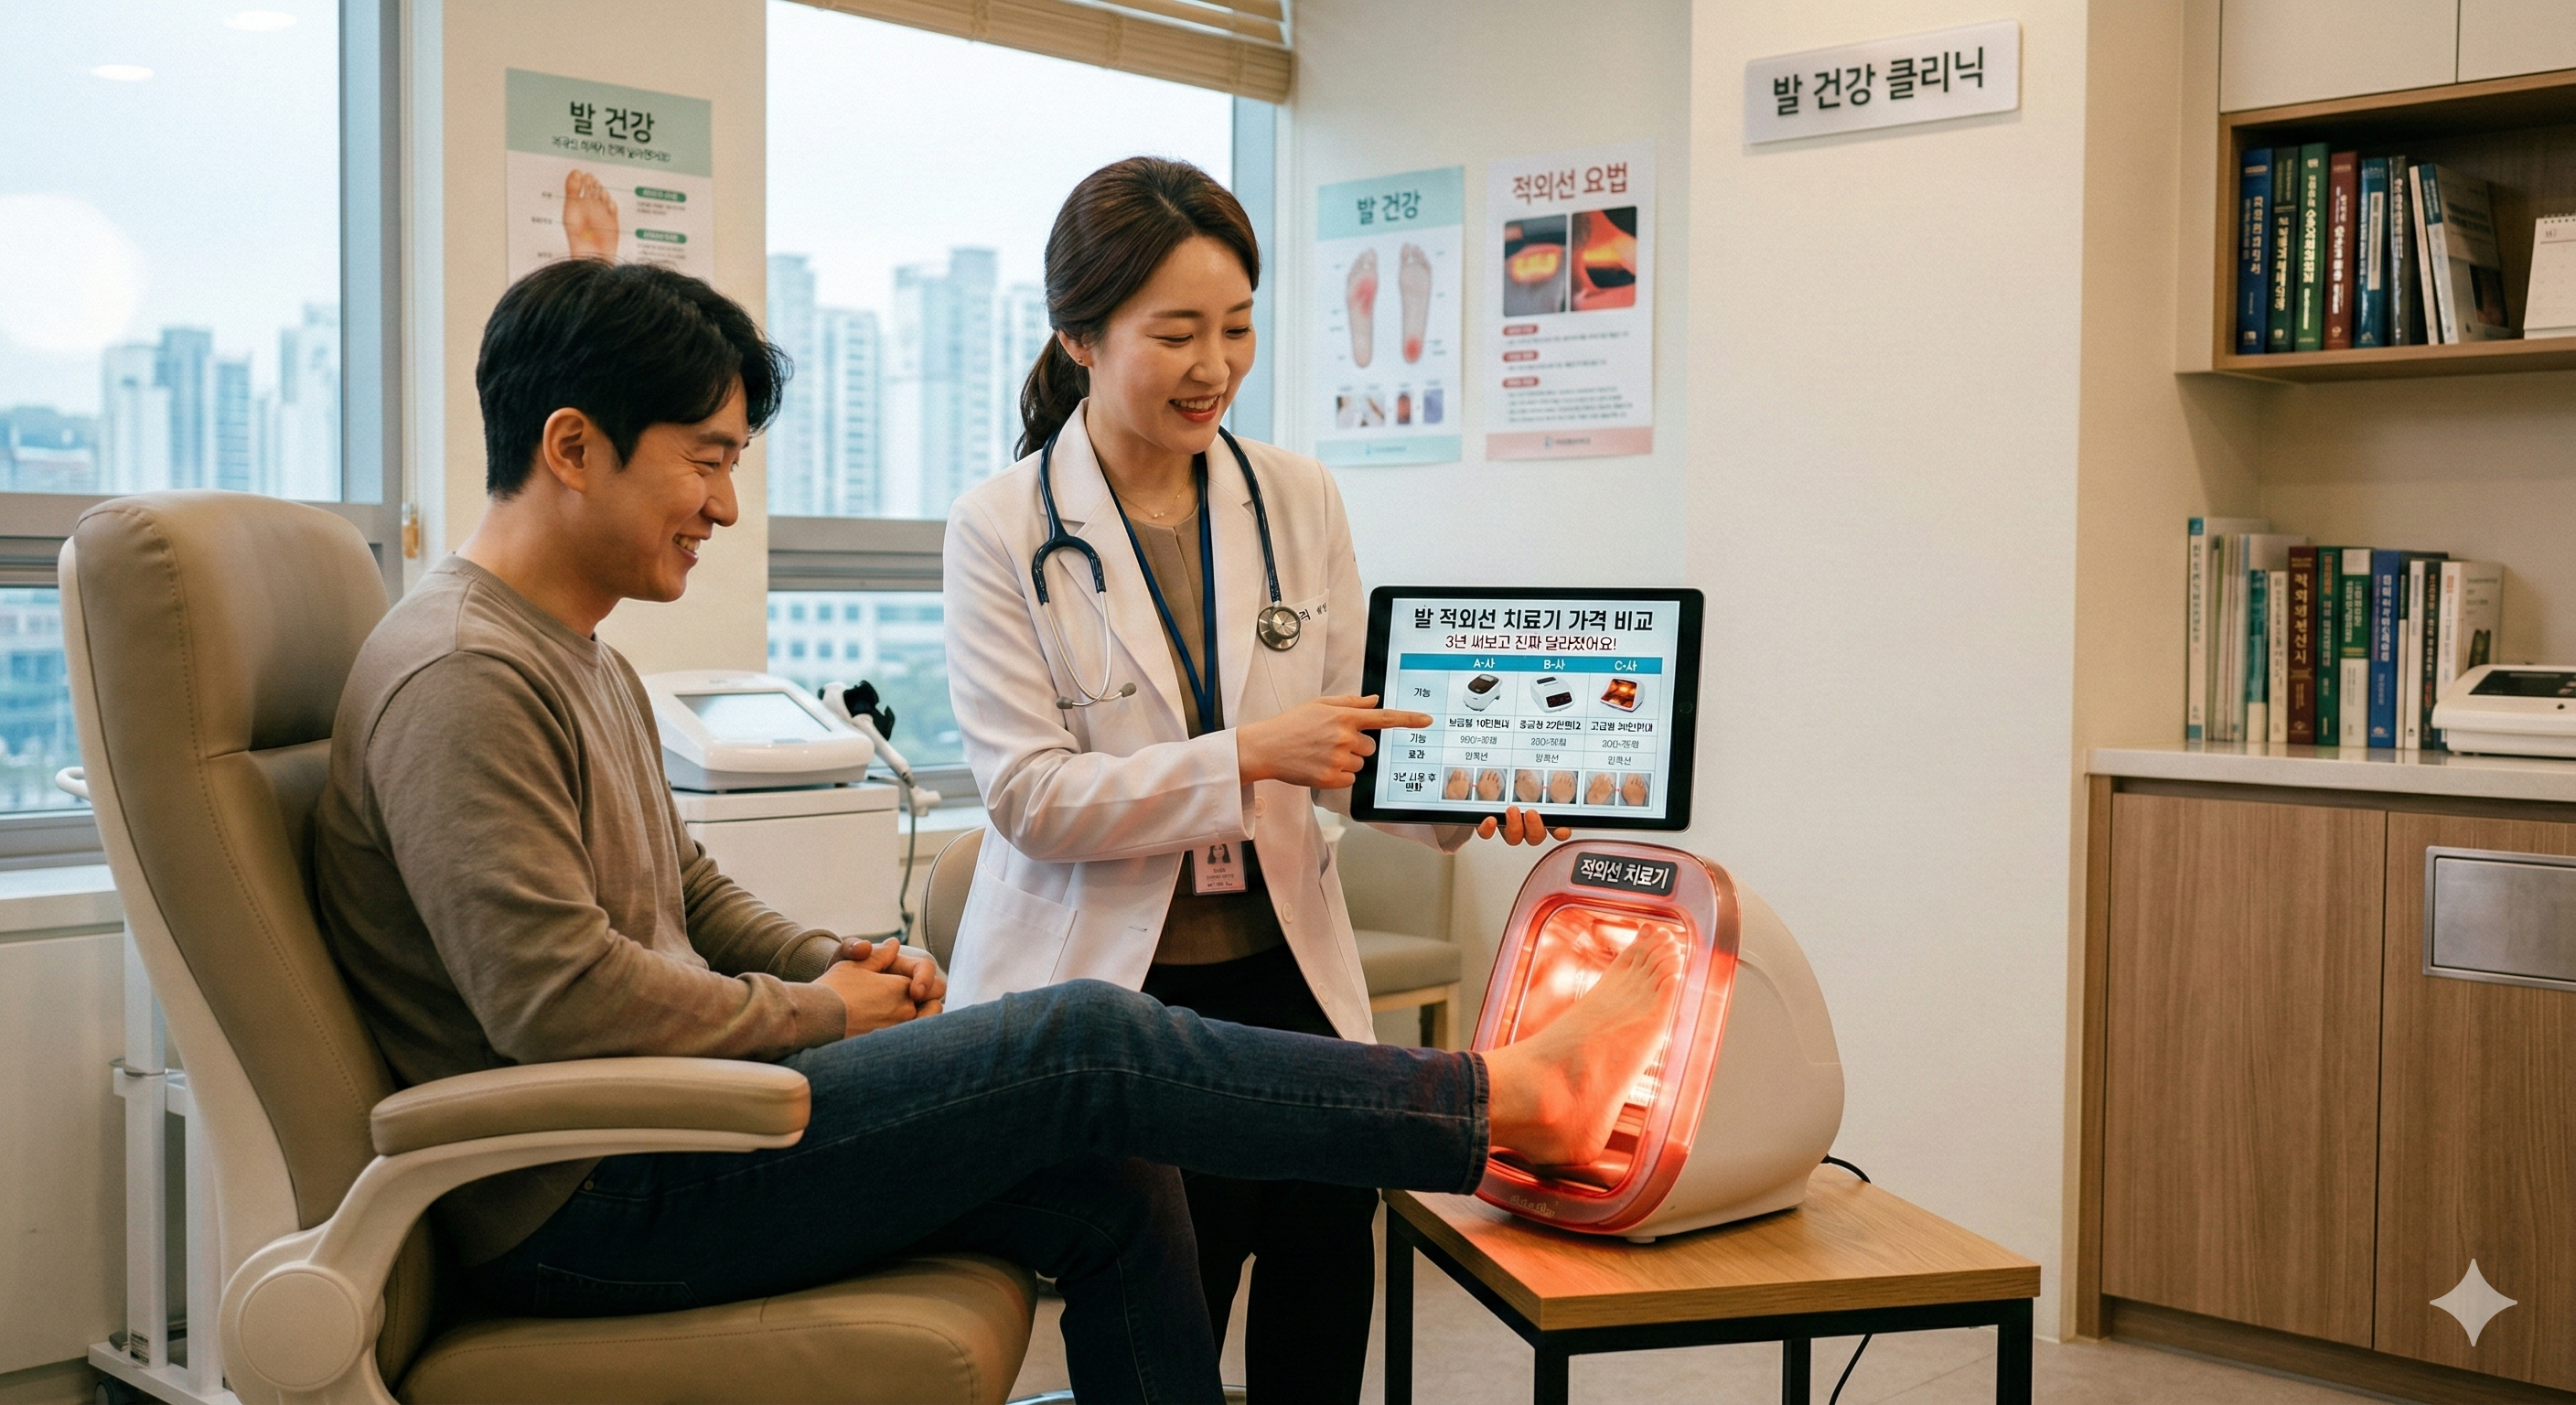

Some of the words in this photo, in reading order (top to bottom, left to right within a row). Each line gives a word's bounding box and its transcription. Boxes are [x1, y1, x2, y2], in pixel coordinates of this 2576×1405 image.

[1773, 74, 1803, 116] 발
[1813, 63, 1876, 110] 건강
[1885, 46, 1984, 100] 클리닉
[570, 101, 596, 136] 발
[605, 108, 655, 144] 건강
[1513, 168, 1576, 205] 적외선
[1583, 161, 1627, 194] 요법
[1357, 197, 1377, 226] 발
[1382, 189, 1422, 221] 건강
[1414, 607, 1434, 629] 발
[1439, 608, 1497, 629] 적외선
[1503, 608, 1562, 630] 치료기
[1569, 609, 1607, 632] 가격
[1614, 610, 1653, 632] 비교
[1445, 634, 1466, 649] 3년
[1471, 634, 1510, 649] 써보고
[1515, 635, 1542, 650] 진짜
[1545, 636, 1617, 651] 달라졌어요!
[1473, 658, 1496, 669] A-사
[1543, 659, 1566, 670] B-사
[1413, 687, 1432, 698] 기능
[1410, 733, 1426, 744] 기능
